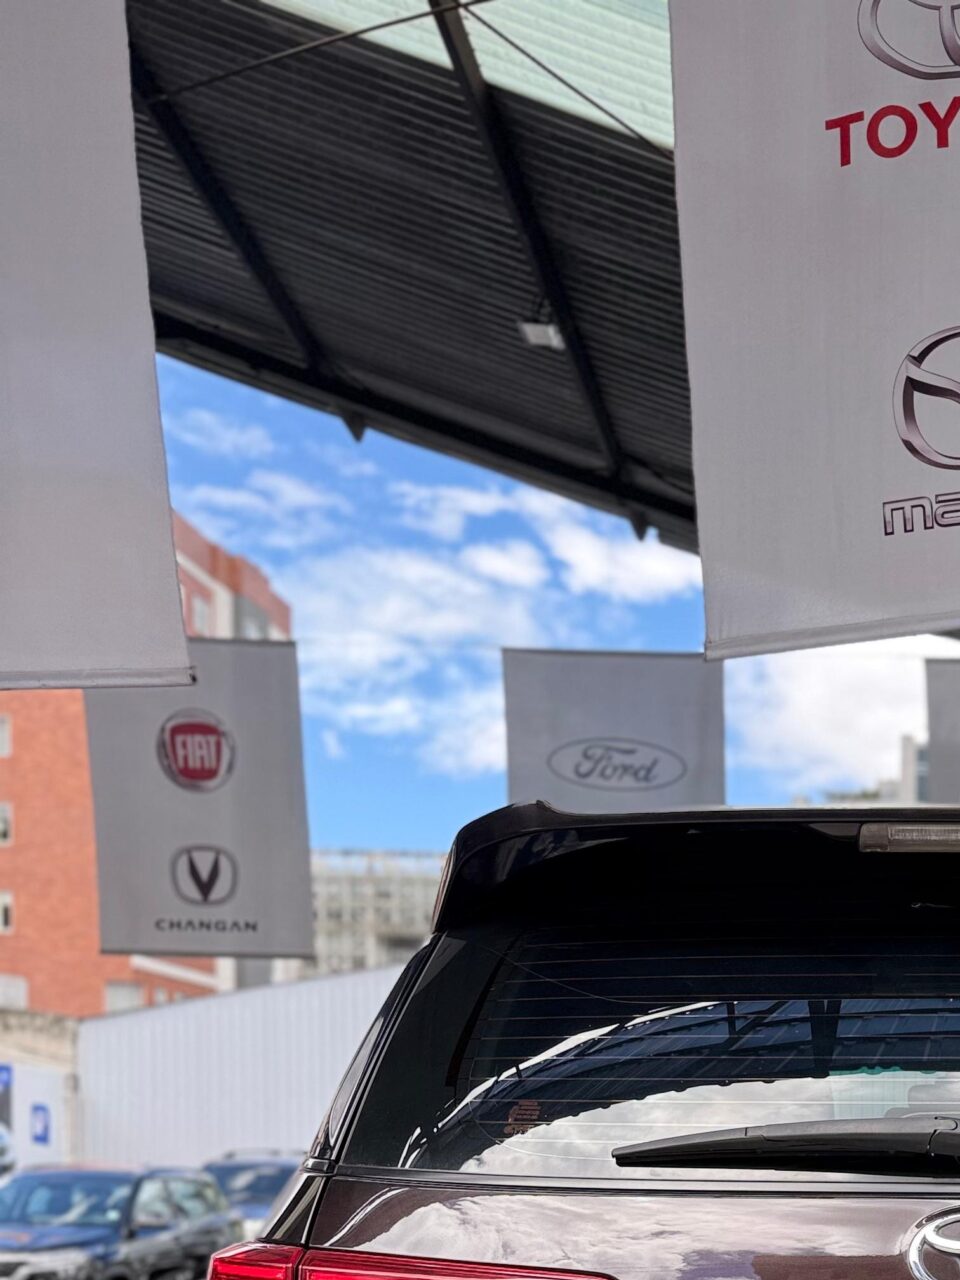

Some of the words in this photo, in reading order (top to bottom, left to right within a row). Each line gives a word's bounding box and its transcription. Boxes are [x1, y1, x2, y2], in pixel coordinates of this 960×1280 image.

[174, 734, 219, 770] FIAT
[573, 744, 660, 783] Ford
[155, 918, 259, 933] CHANGAN
